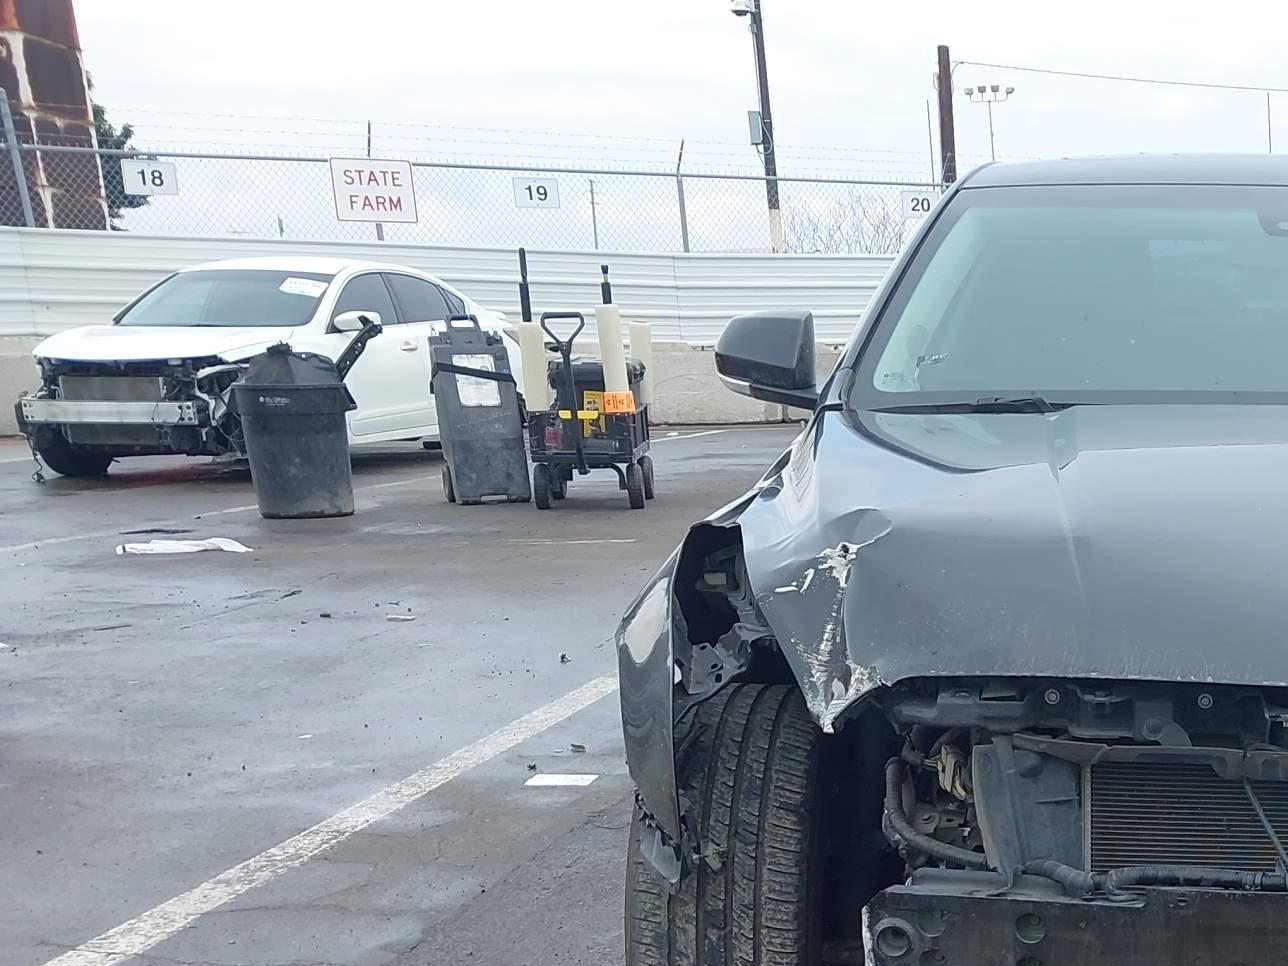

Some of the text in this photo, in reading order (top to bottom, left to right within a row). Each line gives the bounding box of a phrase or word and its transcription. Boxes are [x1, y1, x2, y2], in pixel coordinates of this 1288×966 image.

[136, 169, 164, 187] 18
[343, 169, 403, 187] STATE
[524, 185, 548, 201] 19
[349, 195, 403, 212] FARM
[911, 197, 930, 212] 20
